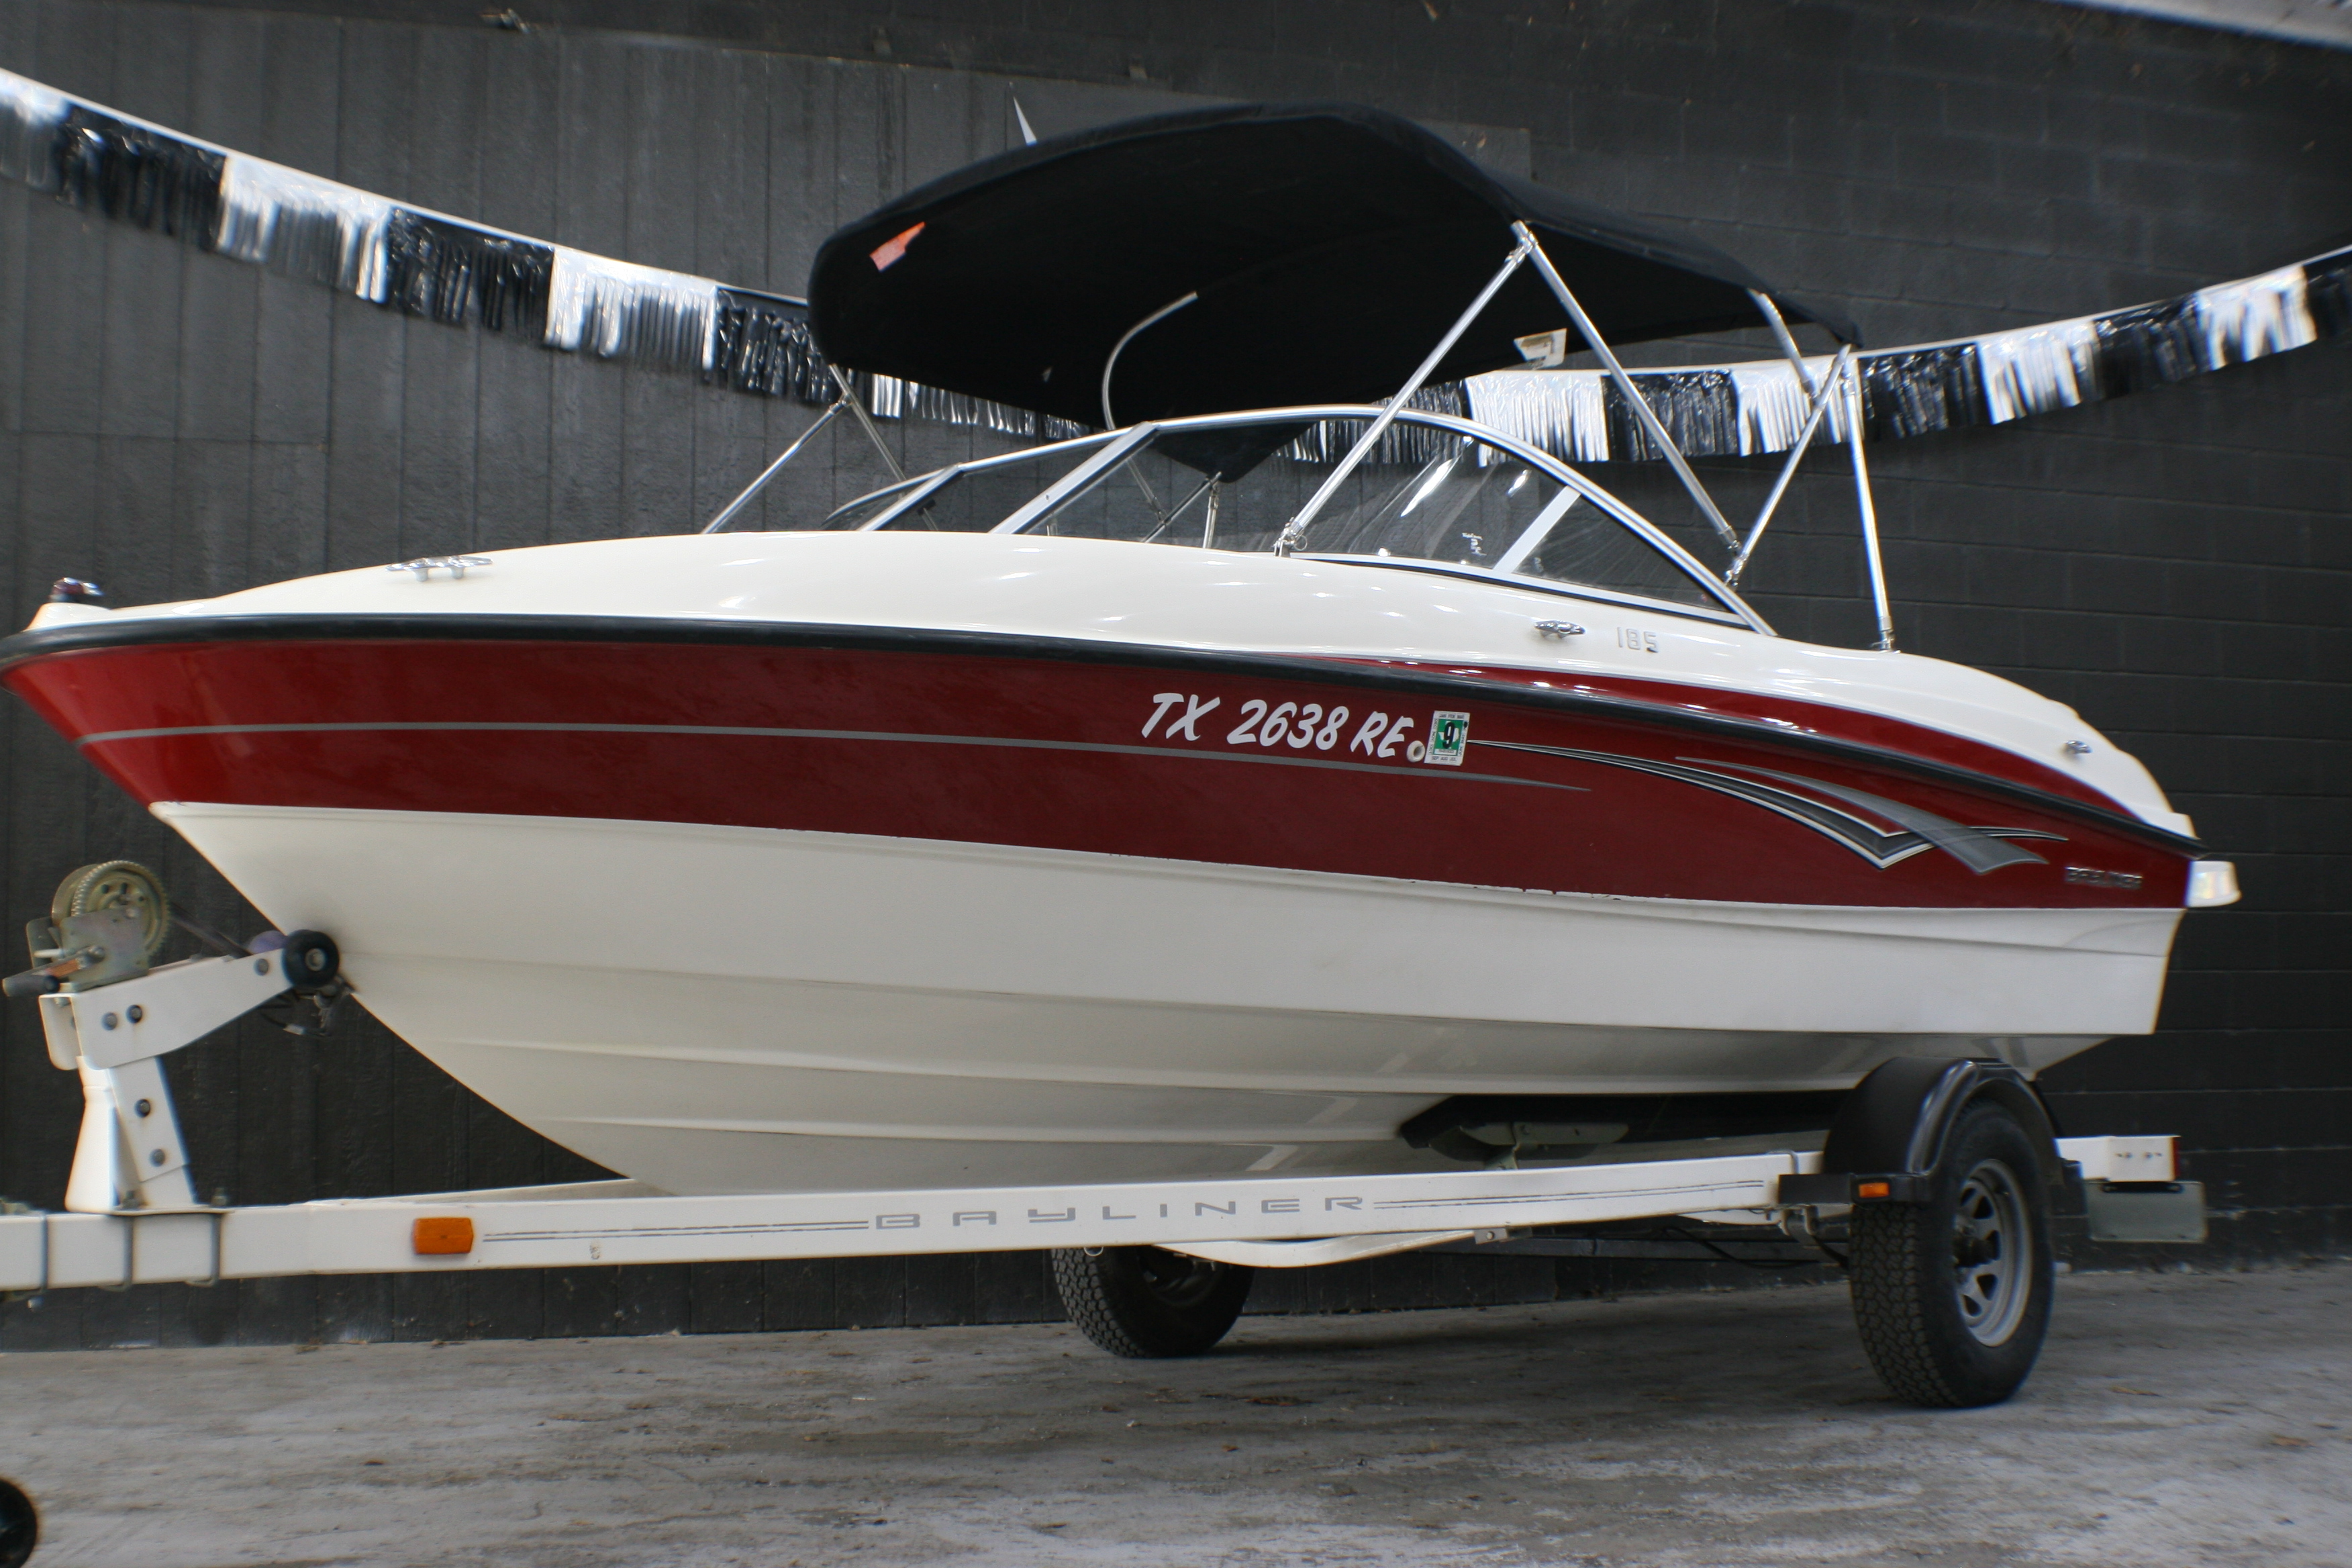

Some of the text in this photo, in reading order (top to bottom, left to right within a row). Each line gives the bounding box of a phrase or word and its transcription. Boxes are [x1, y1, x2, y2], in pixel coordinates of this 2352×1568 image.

[1617, 626, 1659, 653] 185
[1141, 693, 1414, 758] TX 2638 RE
[1442, 722, 1455, 748] 9
[875, 1196, 1363, 1230] BAYLINER
